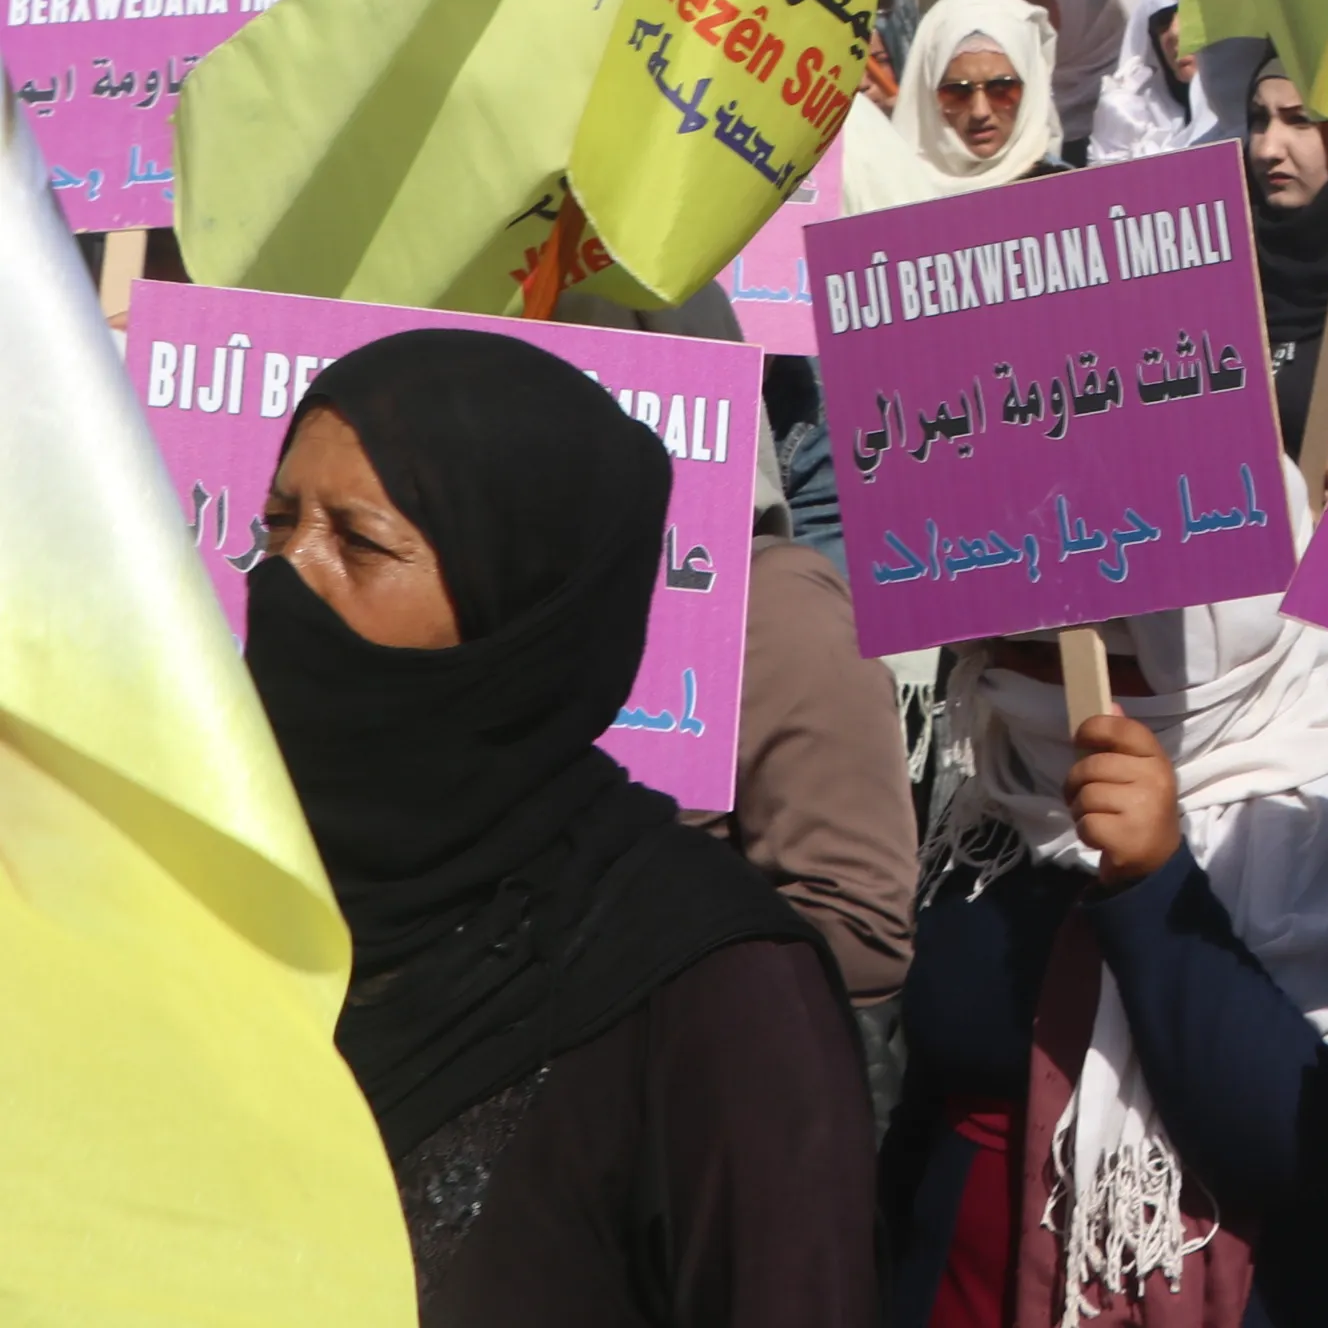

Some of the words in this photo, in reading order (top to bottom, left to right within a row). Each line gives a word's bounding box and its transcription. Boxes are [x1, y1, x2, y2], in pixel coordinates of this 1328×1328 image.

[825, 251, 893, 335] BIJÎ
[897, 224, 1109, 322] BERXWEDANA
[1108, 199, 1233, 281] ÎMRALI
[148, 333, 252, 415] BIJÎ
[993, 350, 1124, 441] مقاومة
[1136, 329, 1247, 406] عاشت
[582, 370, 730, 463] RALI
[853, 374, 987, 483] ايمرالي
